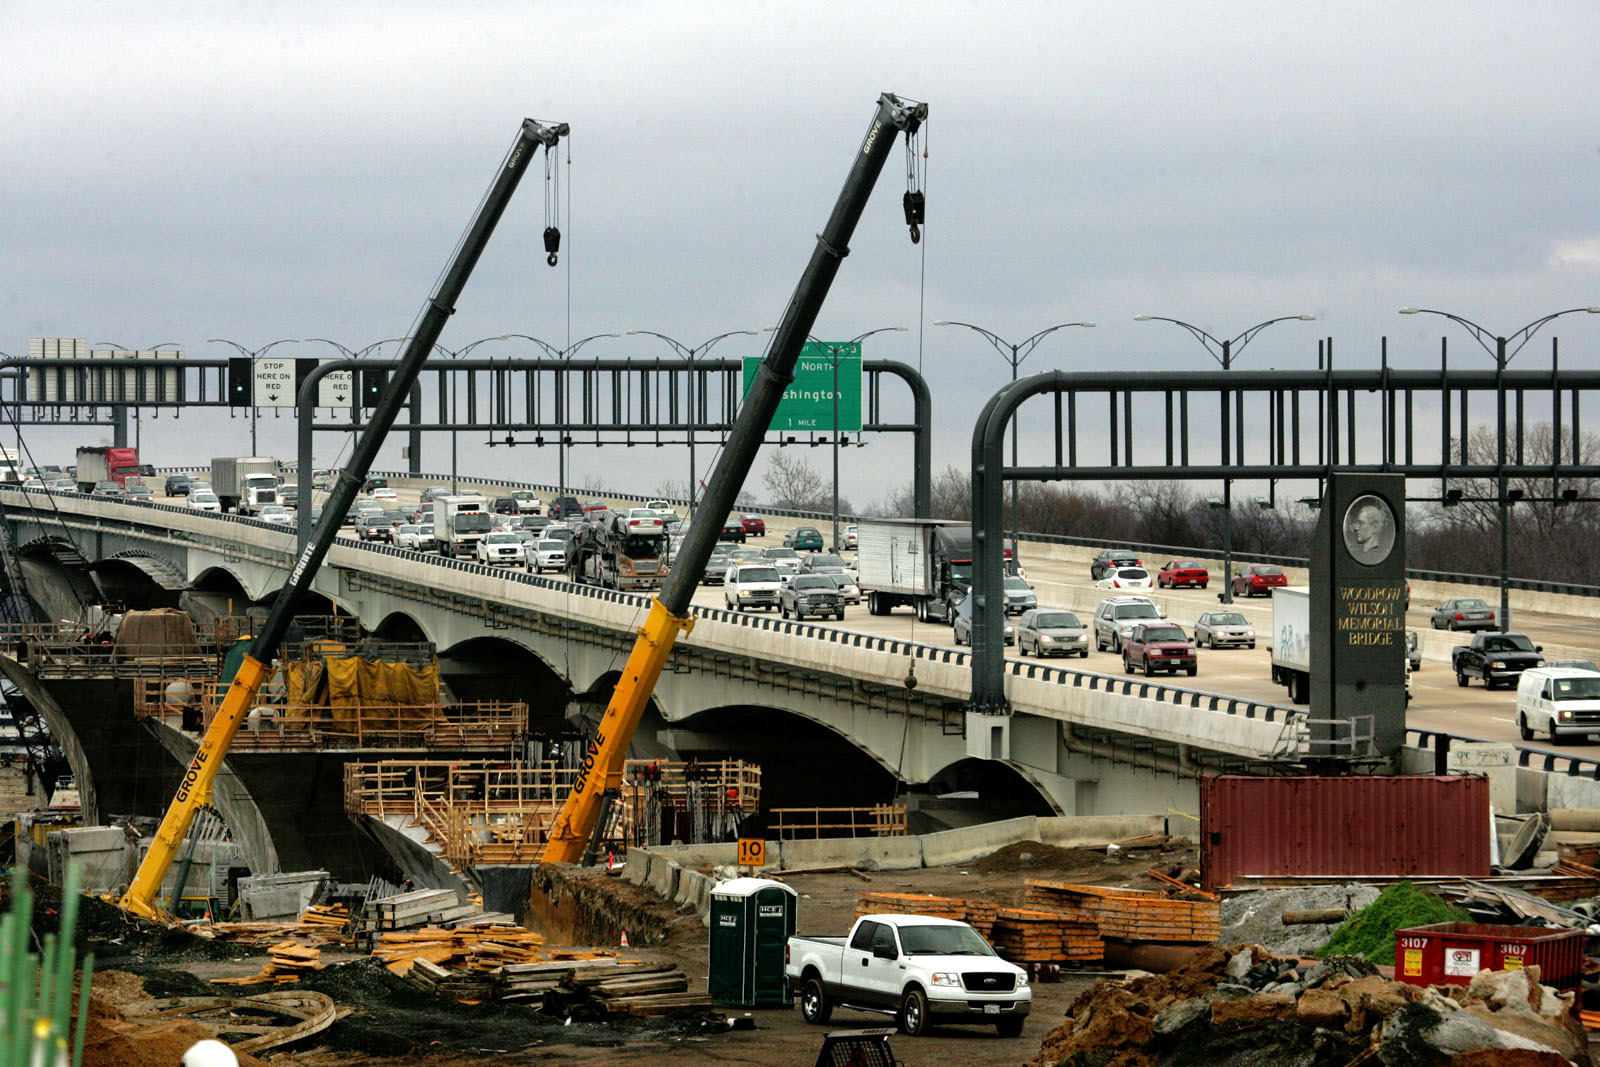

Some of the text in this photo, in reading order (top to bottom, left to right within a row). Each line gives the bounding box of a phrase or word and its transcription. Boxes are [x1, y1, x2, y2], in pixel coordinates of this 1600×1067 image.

[863, 119, 882, 154] GROVE
[801, 361, 835, 372] NORTH
[782, 389, 842, 402] shington
[788, 418, 817, 427] 1 MILE
[289, 541, 317, 586] GRANITE
[1340, 587, 1401, 601] WOODROW
[1347, 602, 1394, 616] WILSON
[1338, 617, 1403, 631] MEMORIAL
[1349, 632, 1393, 646] BRIDGE
[572, 731, 607, 795] GROVE
[175, 750, 209, 804] GROVE
[741, 841, 761, 856] 10
[1401, 938, 1428, 949] 3107
[1500, 944, 1528, 955] 3107
